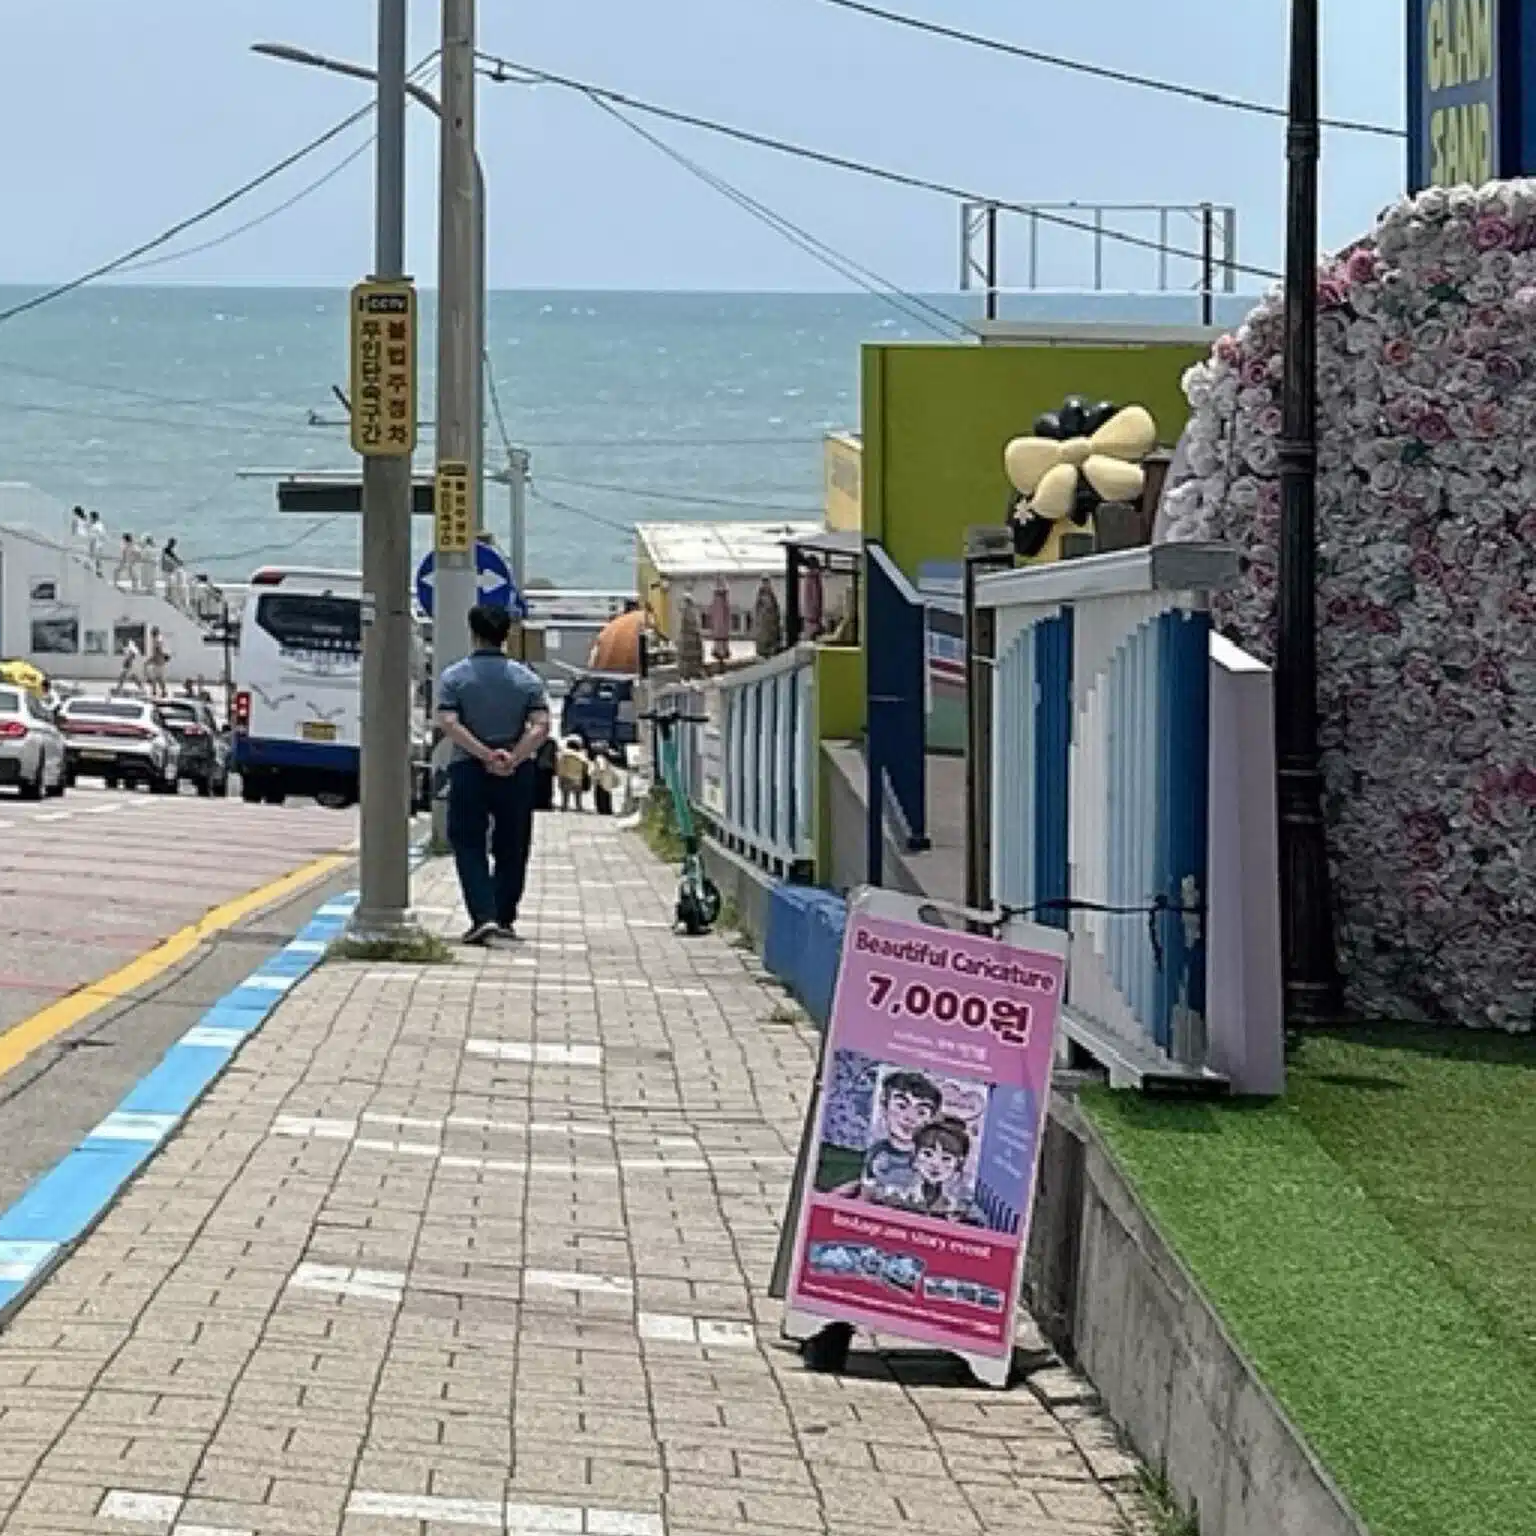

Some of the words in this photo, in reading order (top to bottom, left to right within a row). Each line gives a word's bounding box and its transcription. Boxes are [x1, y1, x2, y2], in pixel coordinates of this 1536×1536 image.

[855, 931, 948, 968] Beautiful
[952, 952, 1053, 990] Caricature
[870, 976, 1029, 1043] 7,000원
